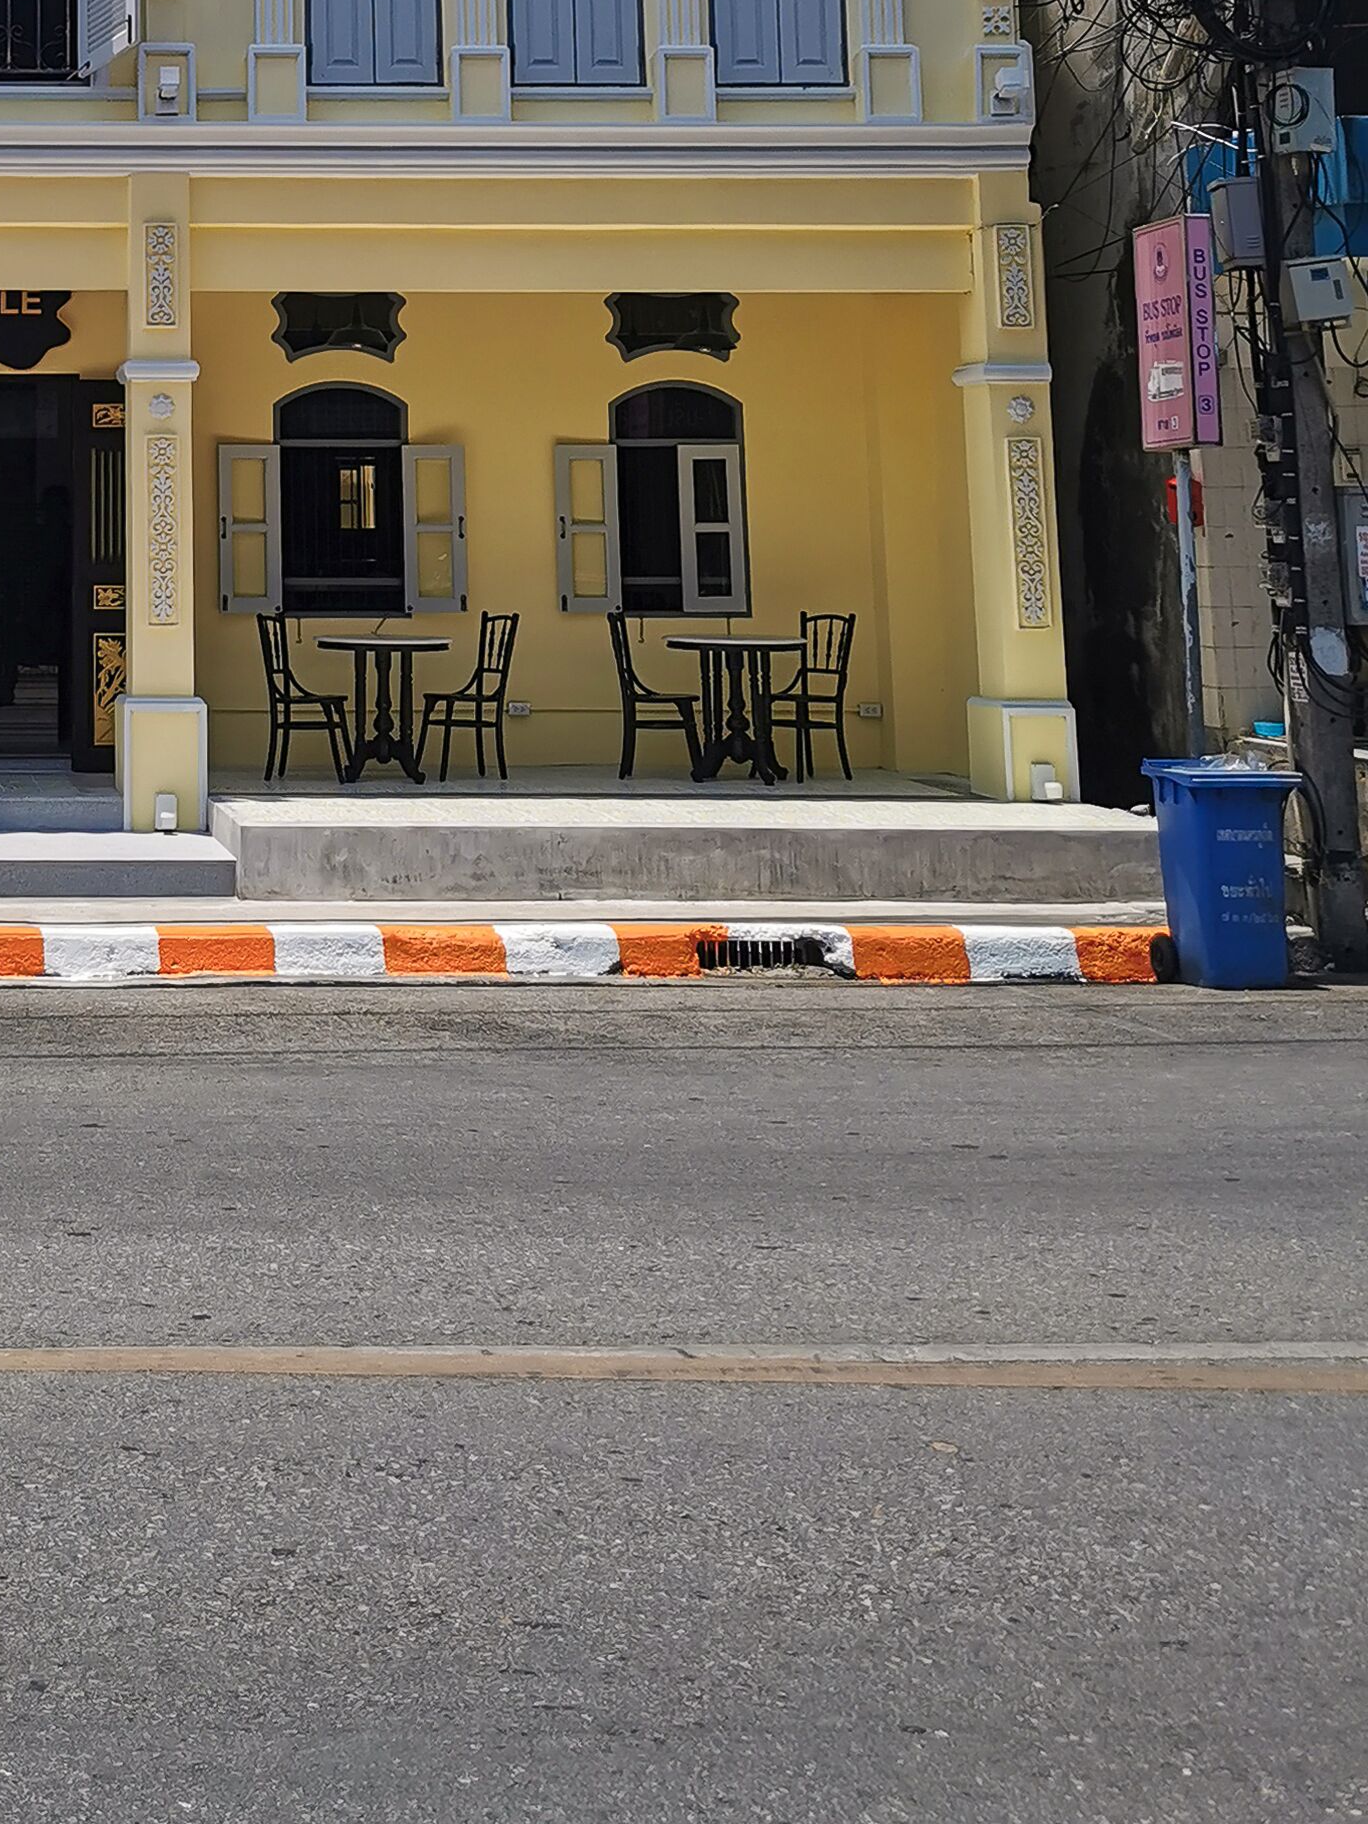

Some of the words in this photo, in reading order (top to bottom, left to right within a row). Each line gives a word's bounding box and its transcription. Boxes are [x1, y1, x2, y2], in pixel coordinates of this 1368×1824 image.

[1193, 248, 1207, 298] BUS
[1143, 300, 1159, 321] BUS
[1160, 295, 1183, 317] STOP
[1196, 309, 1211, 376] STOP
[1201, 398, 1212, 412] 3
